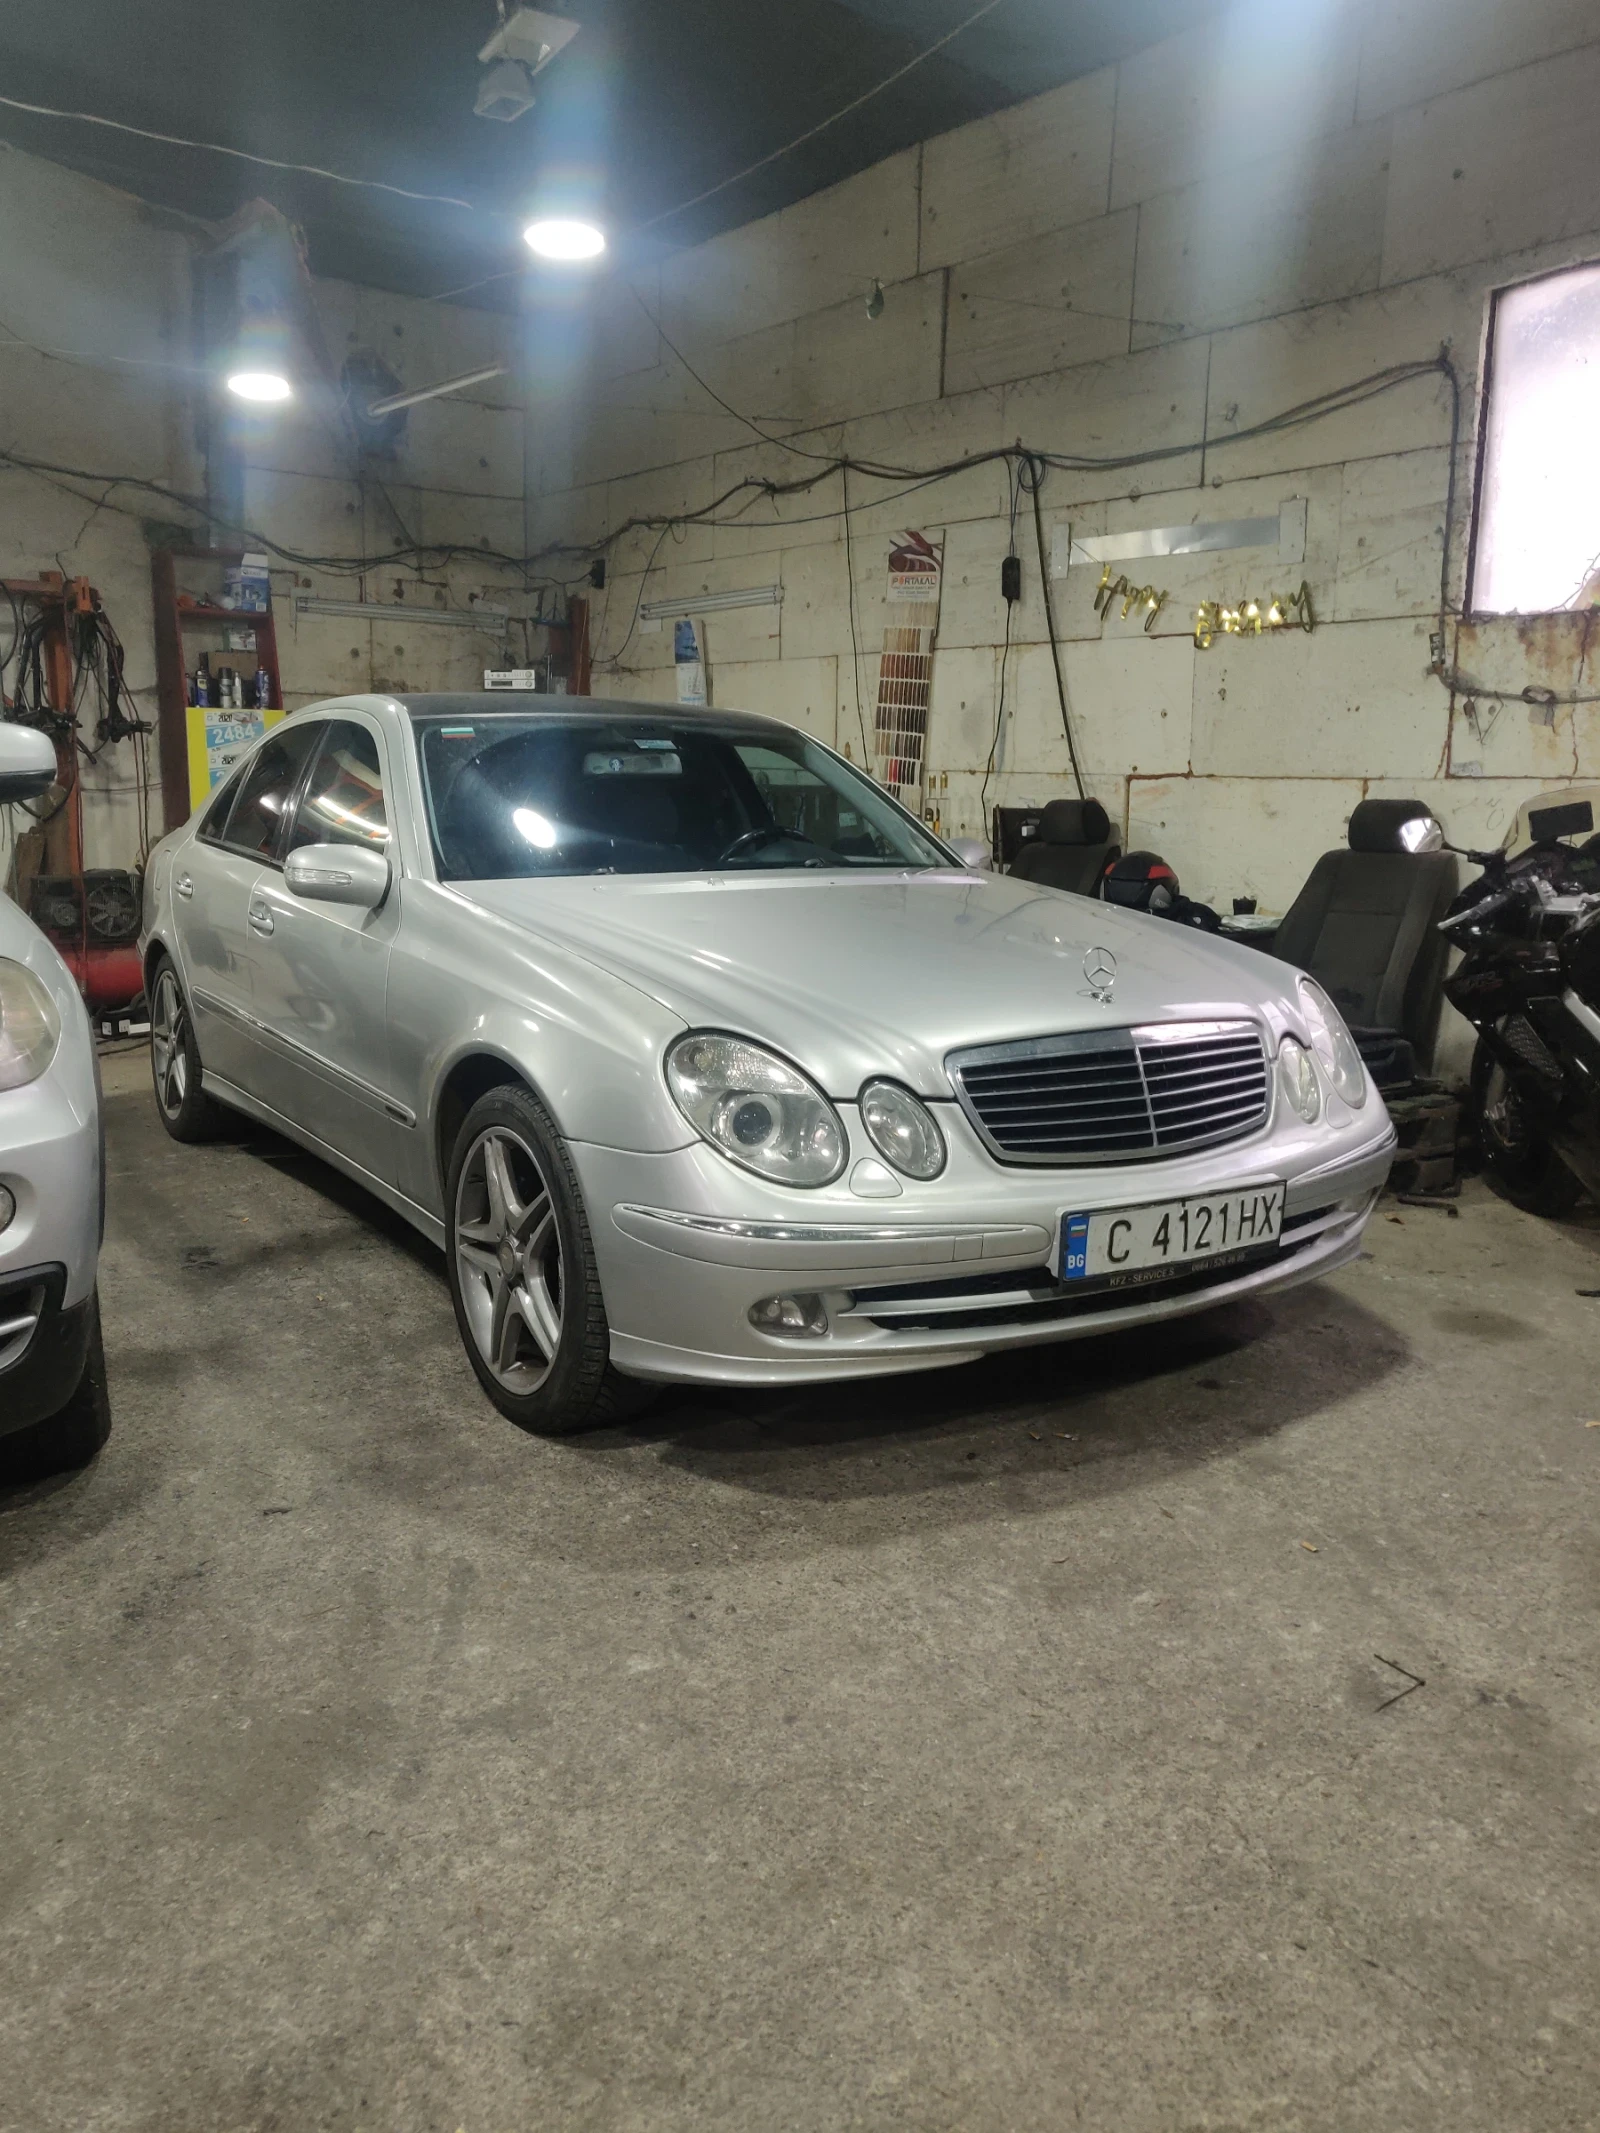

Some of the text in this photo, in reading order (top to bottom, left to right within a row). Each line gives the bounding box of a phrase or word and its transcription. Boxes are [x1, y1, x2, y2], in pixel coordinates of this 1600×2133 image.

[213, 723, 256, 744] 2484
[1107, 1219, 1132, 1264] C
[1067, 1254, 1085, 1269] BG
[1109, 1276, 1126, 1286] KFZ
